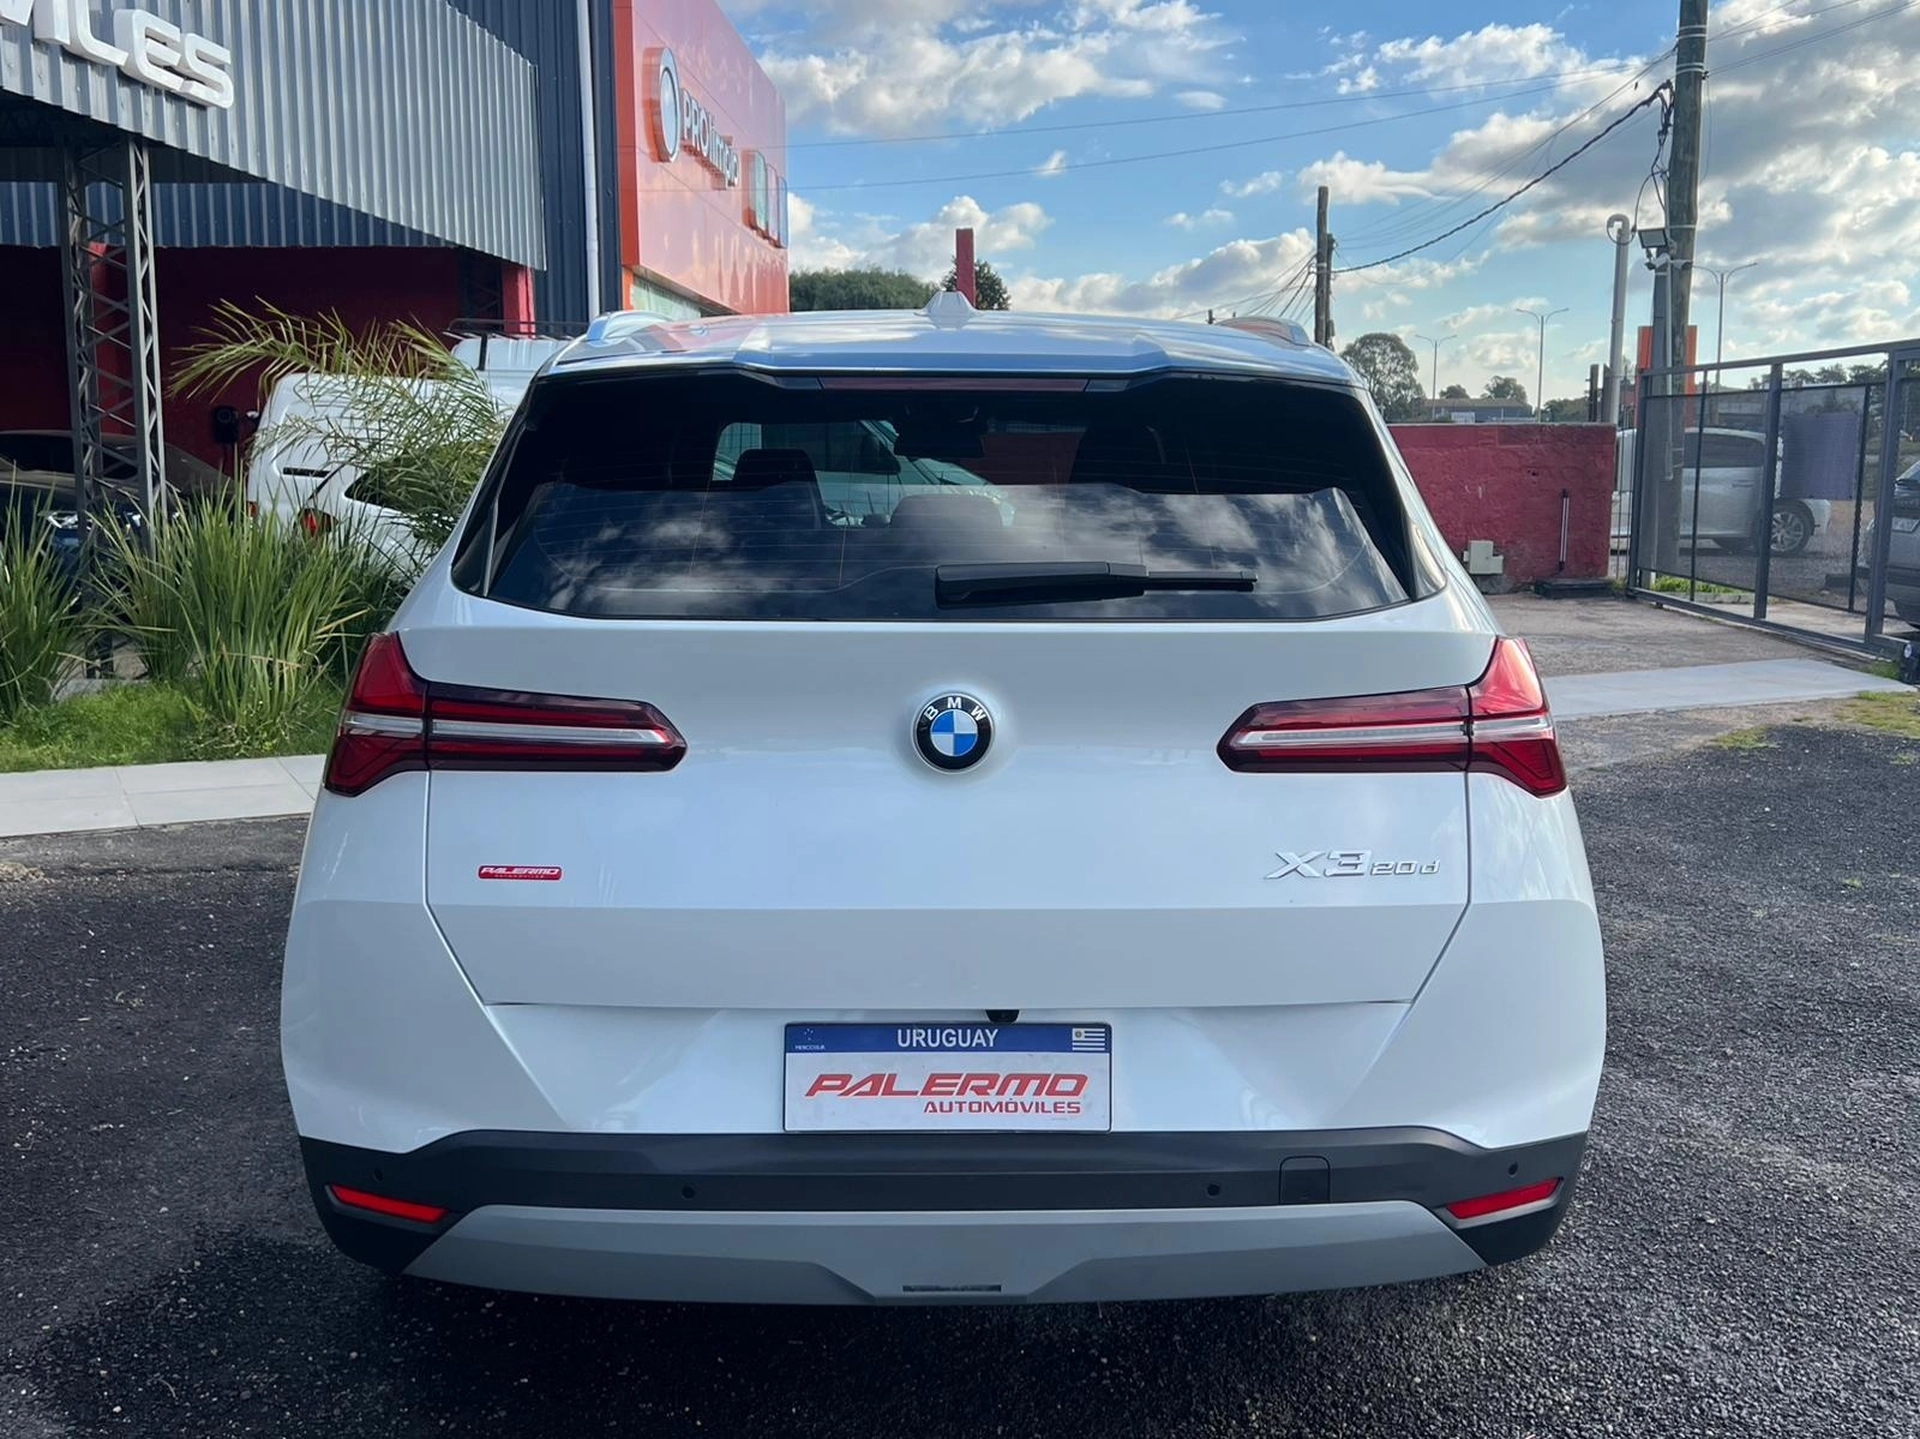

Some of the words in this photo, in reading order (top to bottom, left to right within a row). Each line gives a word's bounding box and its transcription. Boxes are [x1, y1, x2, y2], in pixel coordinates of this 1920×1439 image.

[923, 697, 986, 721] BMW
[480, 867, 560, 875] PALERMO
[1264, 850, 1371, 880] X3
[1370, 859, 1441, 877] 20d
[897, 1028, 999, 1048] URUGUAY
[805, 1073, 1089, 1097] PALERMO
[924, 1098, 1081, 1114] AUTOMÓVILES
